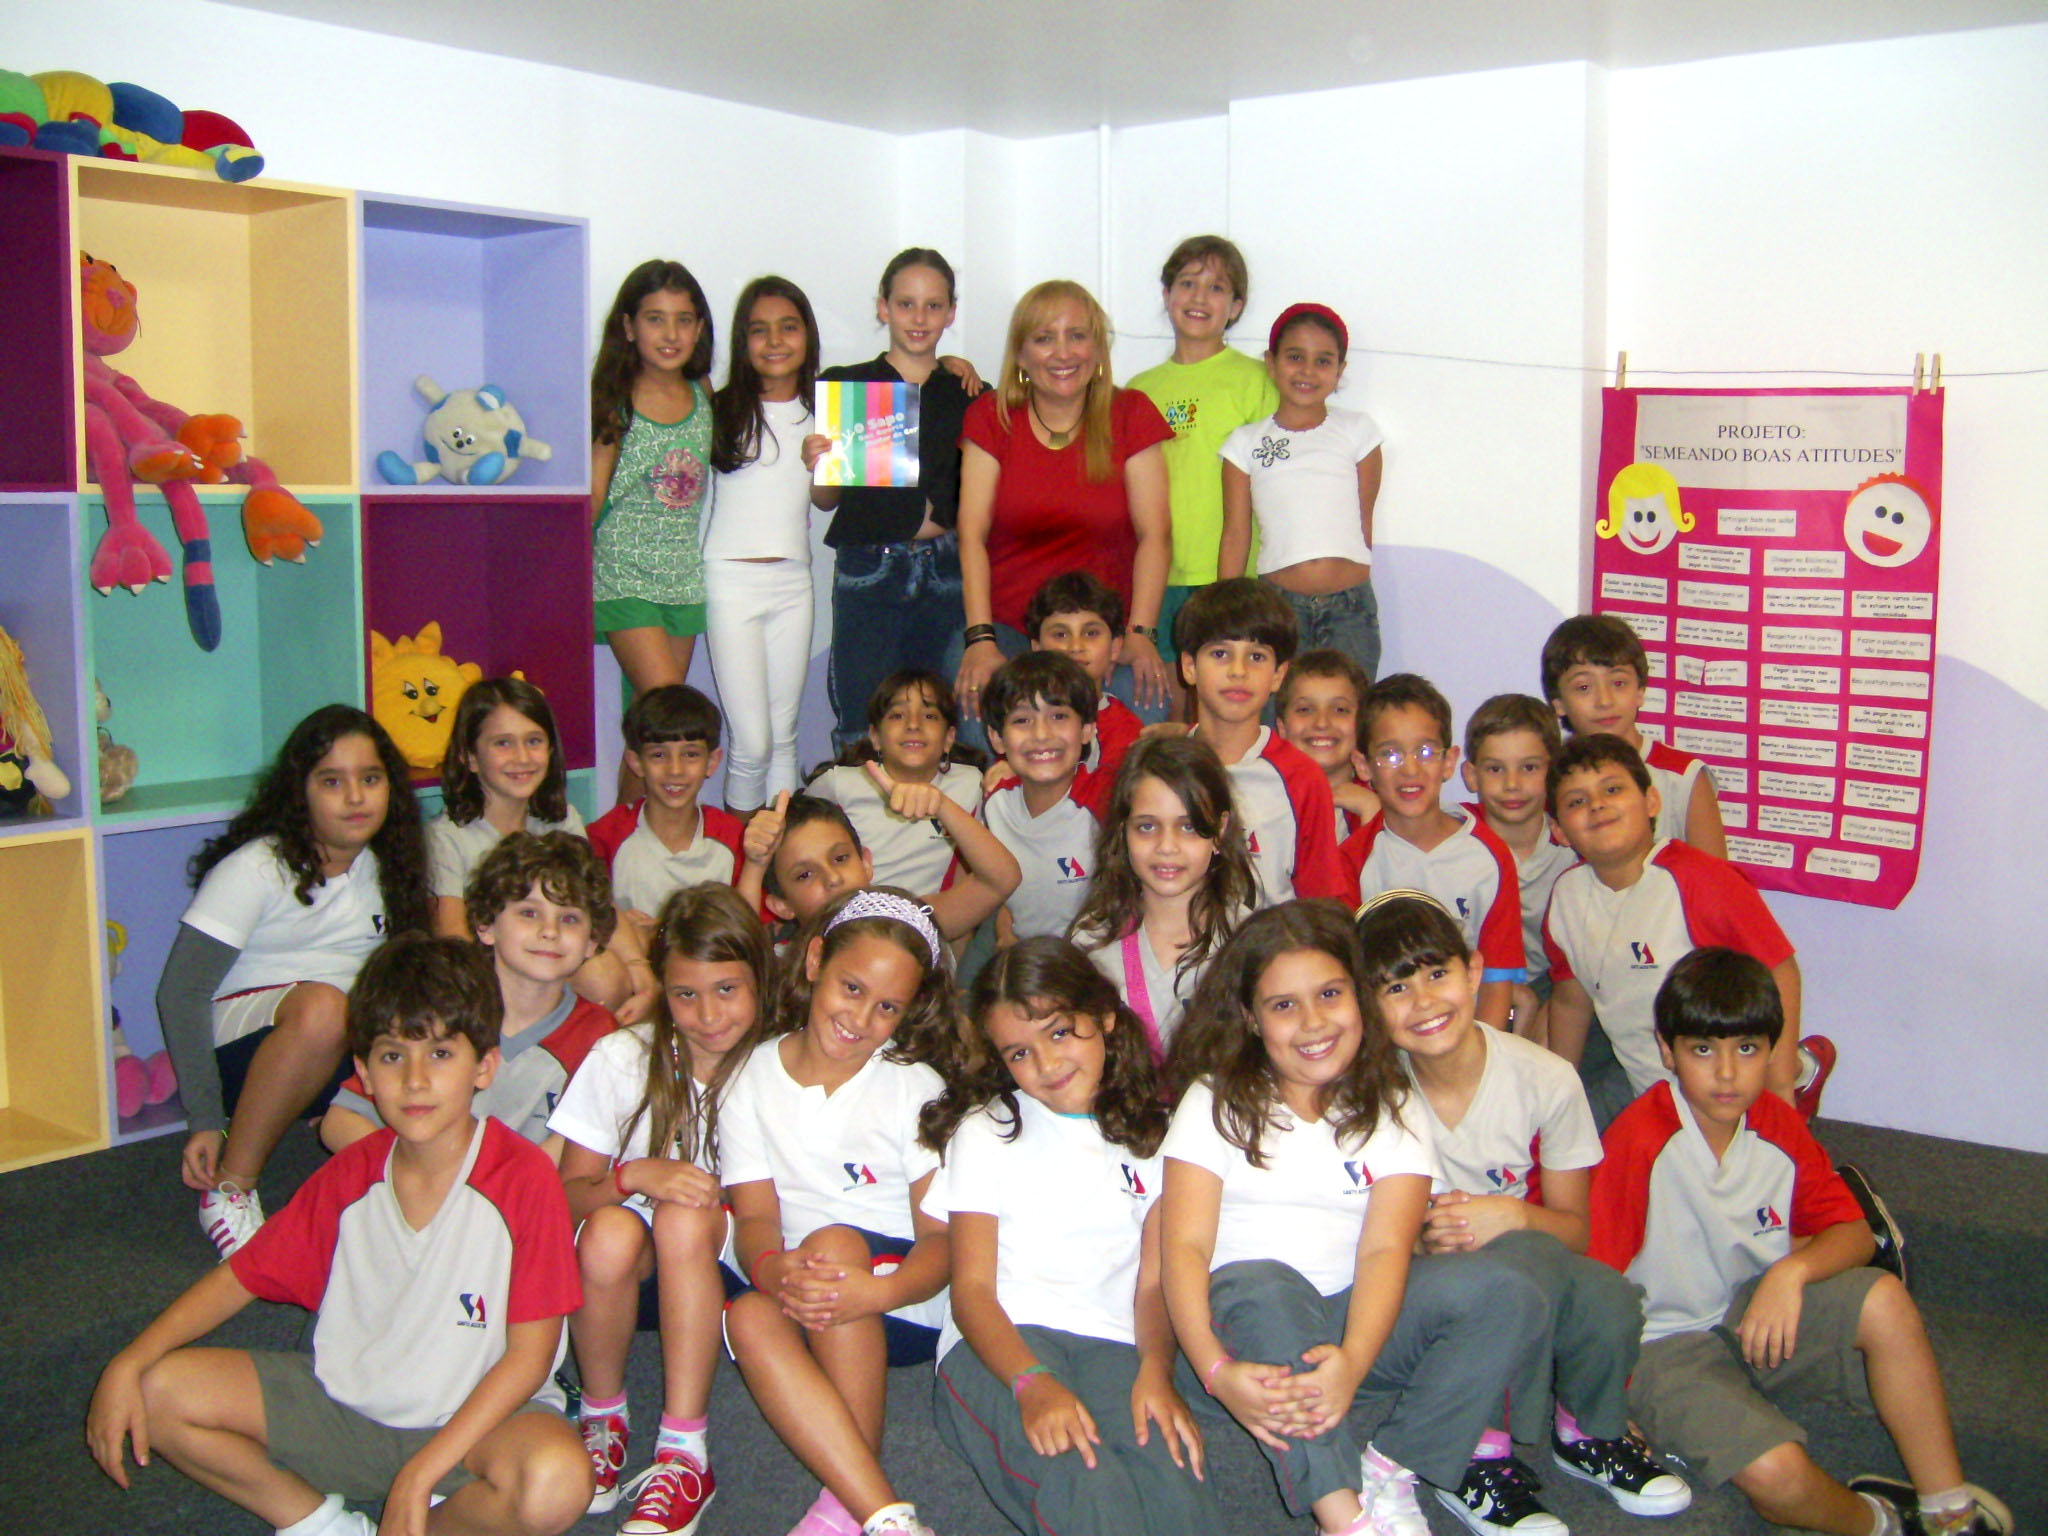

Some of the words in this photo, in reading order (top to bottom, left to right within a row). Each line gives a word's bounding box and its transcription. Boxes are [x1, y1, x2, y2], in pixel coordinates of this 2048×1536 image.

[1717, 425, 1807, 439] PROJETO:
[1641, 445, 1738, 461] "SEMEANDO
[1743, 449, 1791, 462] BOAS
[1797, 449, 1902, 463] ATITUDES"
